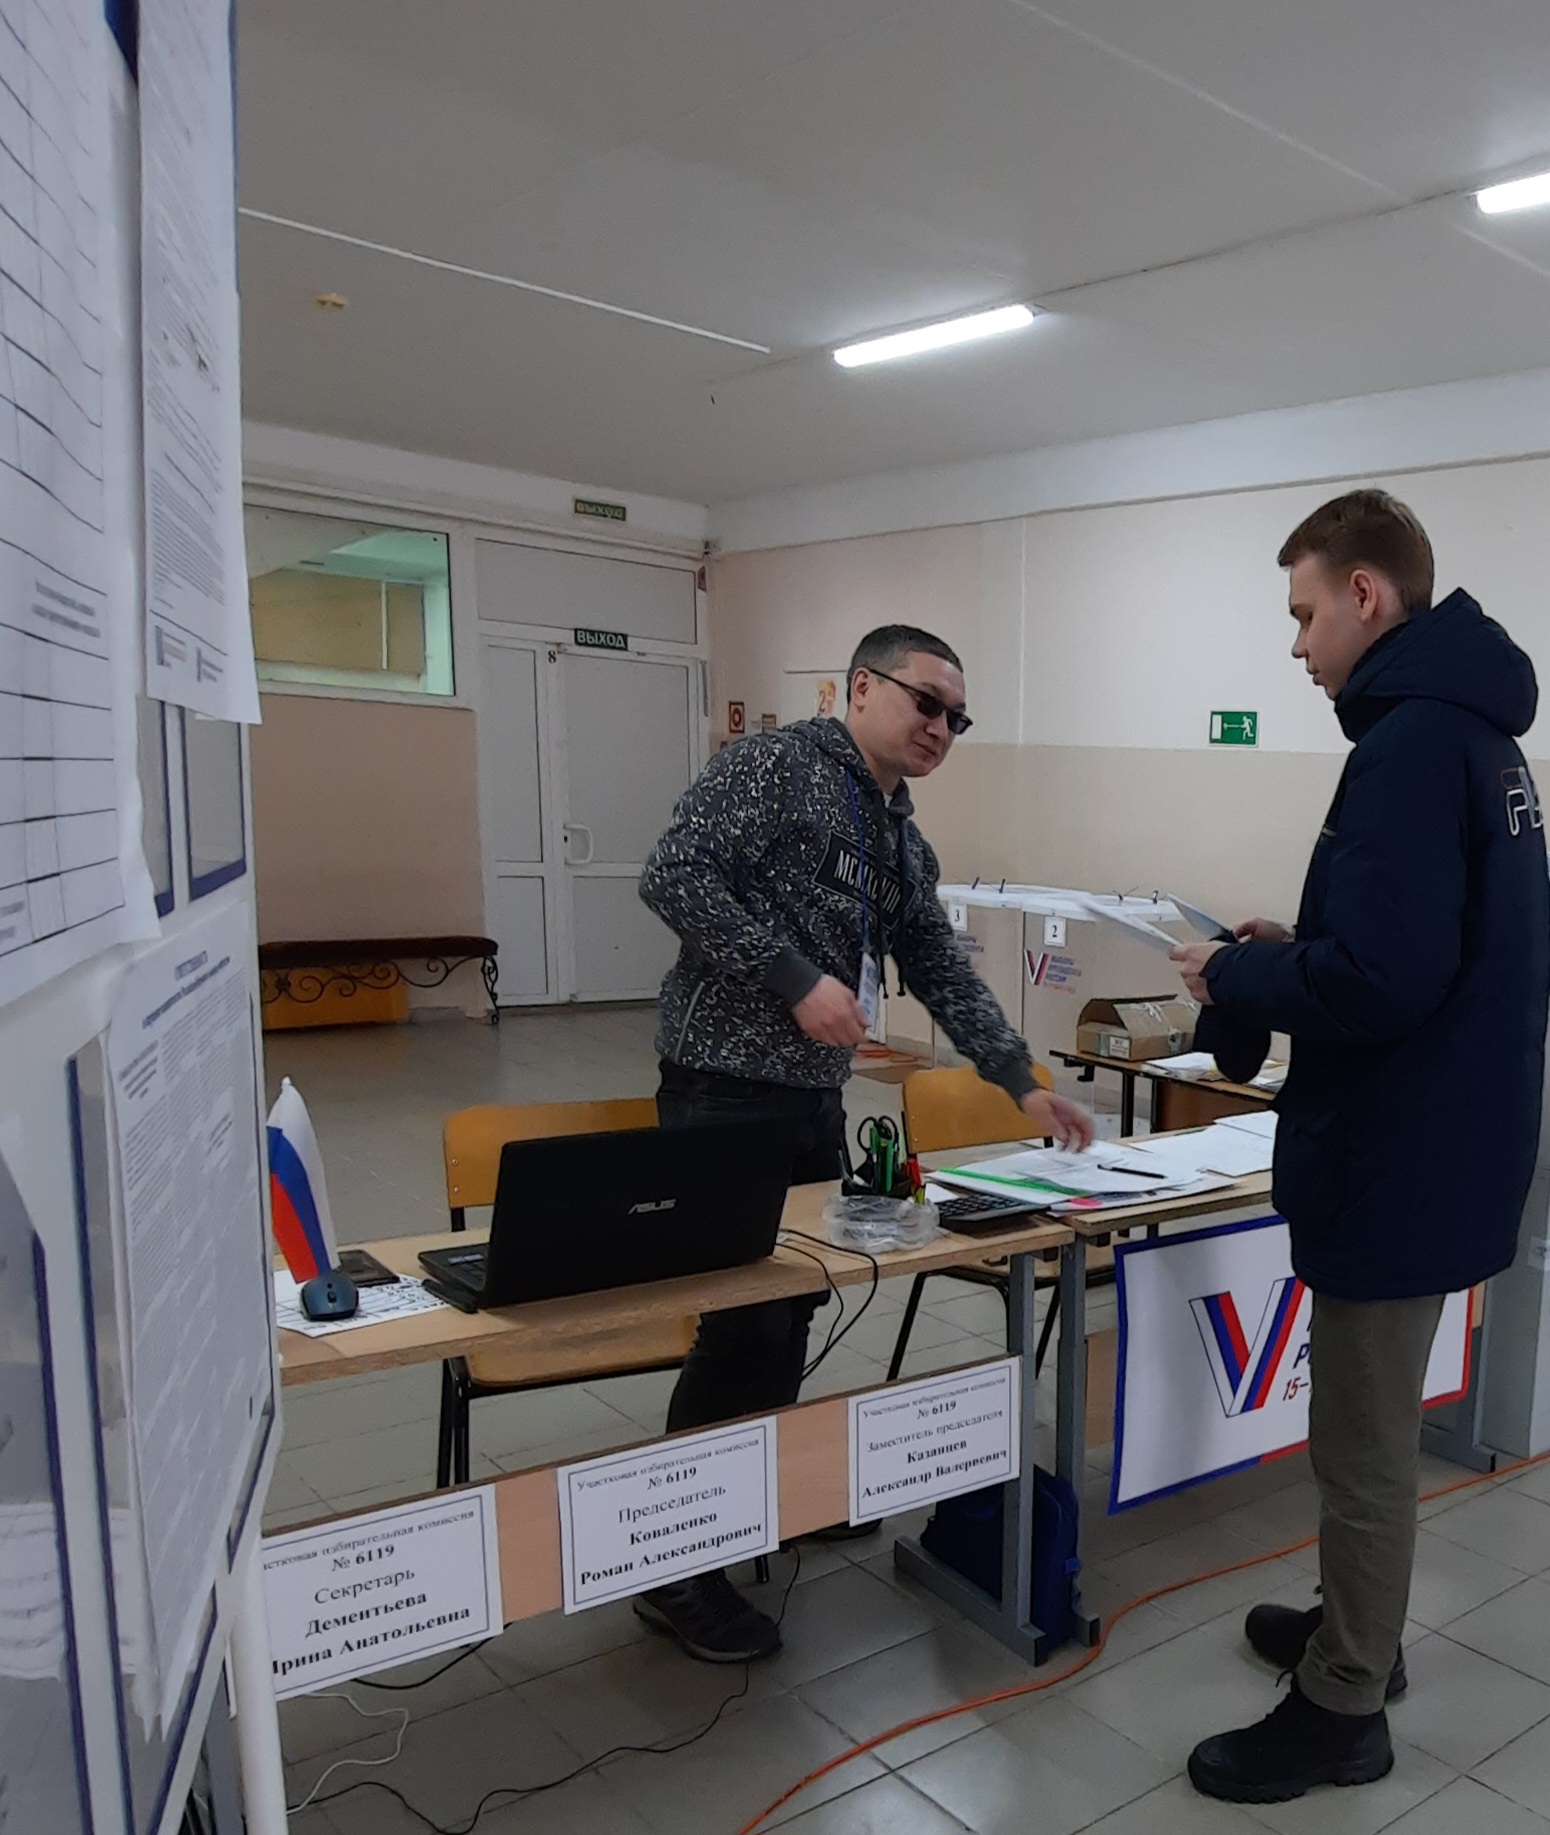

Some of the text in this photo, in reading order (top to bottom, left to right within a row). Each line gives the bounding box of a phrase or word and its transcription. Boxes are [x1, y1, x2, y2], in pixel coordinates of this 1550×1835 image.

[576, 629, 627, 649] ВЫХОД
[548, 650, 557, 664] 8
[954, 909, 961, 923] 3
[1051, 925, 1059, 938] 2
[627, 1198, 677, 1215] ASUS
[932, 1400, 957, 1415] 6119
[867, 1409, 1003, 1453] Заместитель председателя
[577, 1438, 760, 1491] Участковая избирательная комиссия
[907, 1440, 967, 1464] Казанцев
[665, 1466, 697, 1484] 6119
[862, 1450, 1007, 1499] Александр Валерьевич
[618, 1484, 727, 1524] Председатель
[322, 1526, 414, 1556] избирательная
[417, 1509, 475, 1532] комиссия
[629, 1512, 717, 1546] Коваленко
[331, 1544, 396, 1573] № 6119
[580, 1522, 762, 1586] Роман Александрович
[314, 1568, 416, 1605] Секретарь
[304, 1592, 428, 1639] Дементьева
[339, 1607, 471, 1655] Анатольевна
